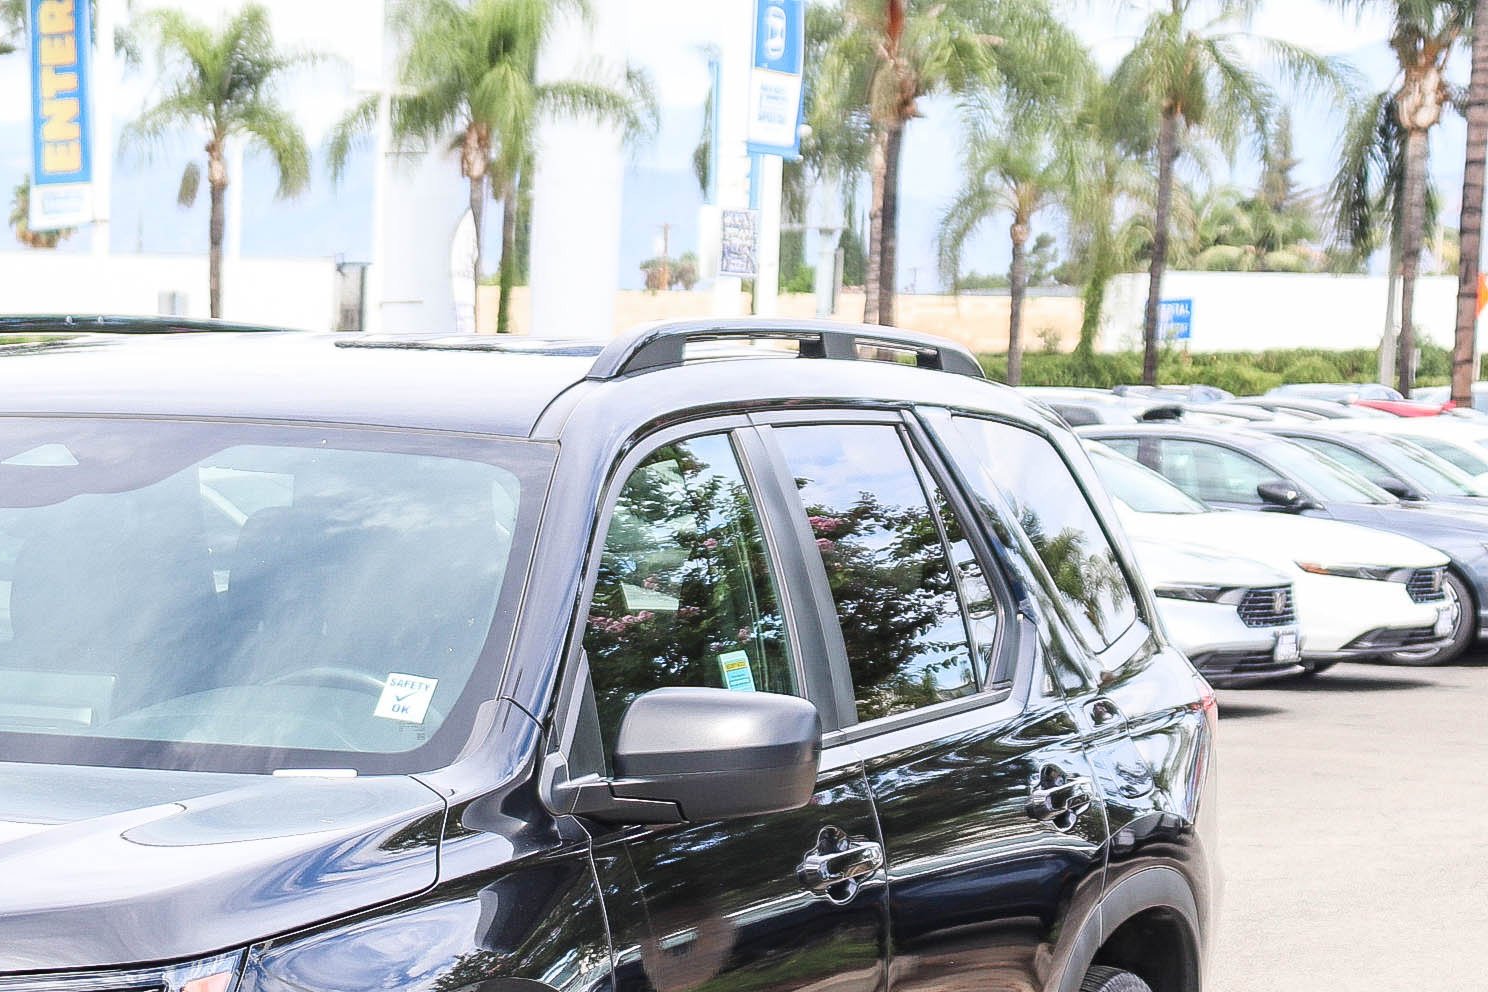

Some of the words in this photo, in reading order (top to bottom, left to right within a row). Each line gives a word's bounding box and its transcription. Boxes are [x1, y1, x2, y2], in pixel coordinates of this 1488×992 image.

[38, 0, 82, 174] ENTER
[389, 678, 431, 692] SAFETY
[391, 703, 410, 714] OK
